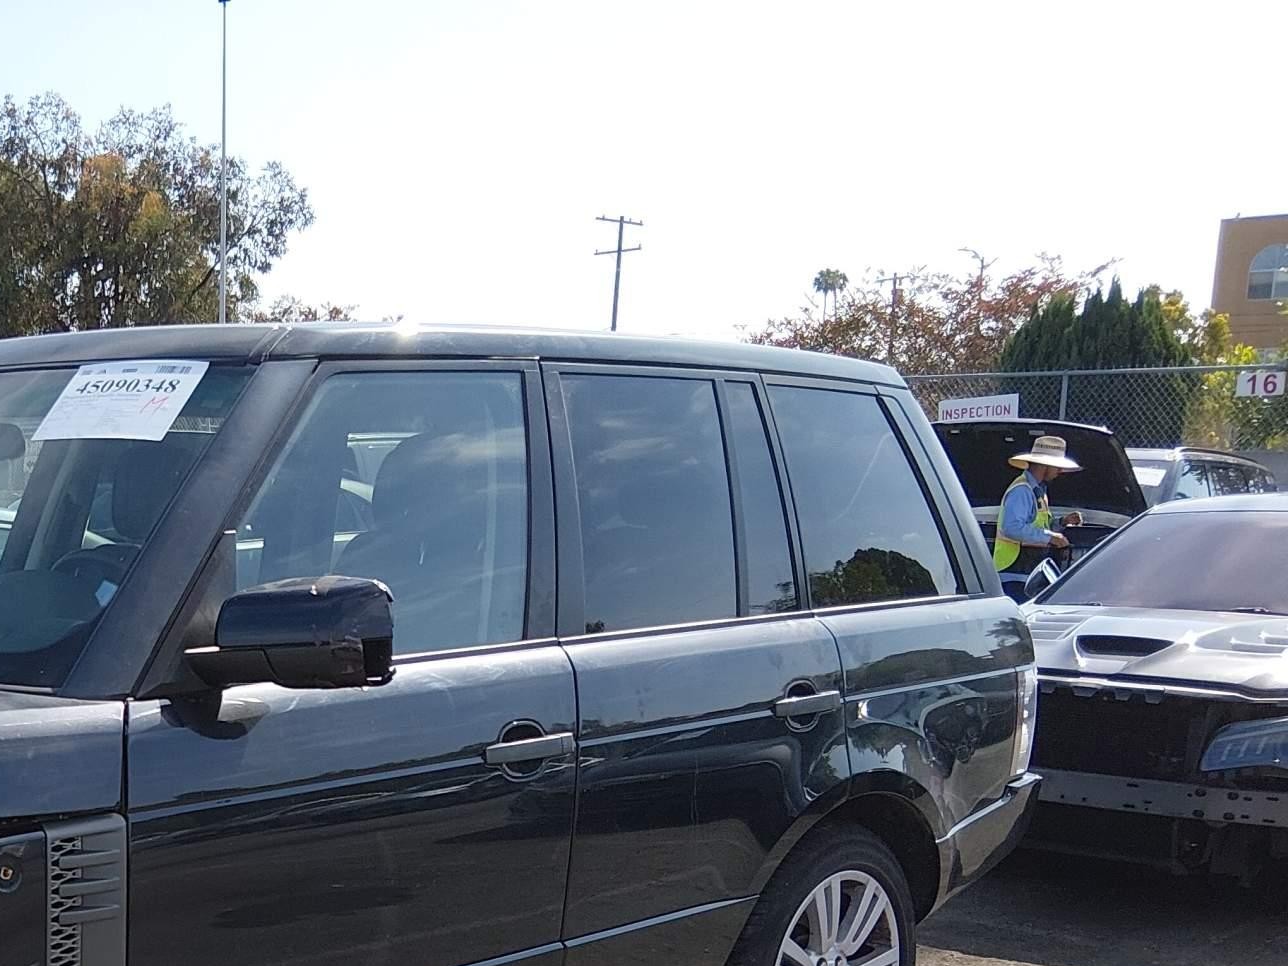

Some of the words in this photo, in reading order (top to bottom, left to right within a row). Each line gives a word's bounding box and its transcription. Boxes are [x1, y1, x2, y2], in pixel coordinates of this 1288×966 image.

[76, 379, 181, 395] 45090348
[1247, 374, 1277, 395] 16
[942, 404, 1011, 420] INSPECTION
